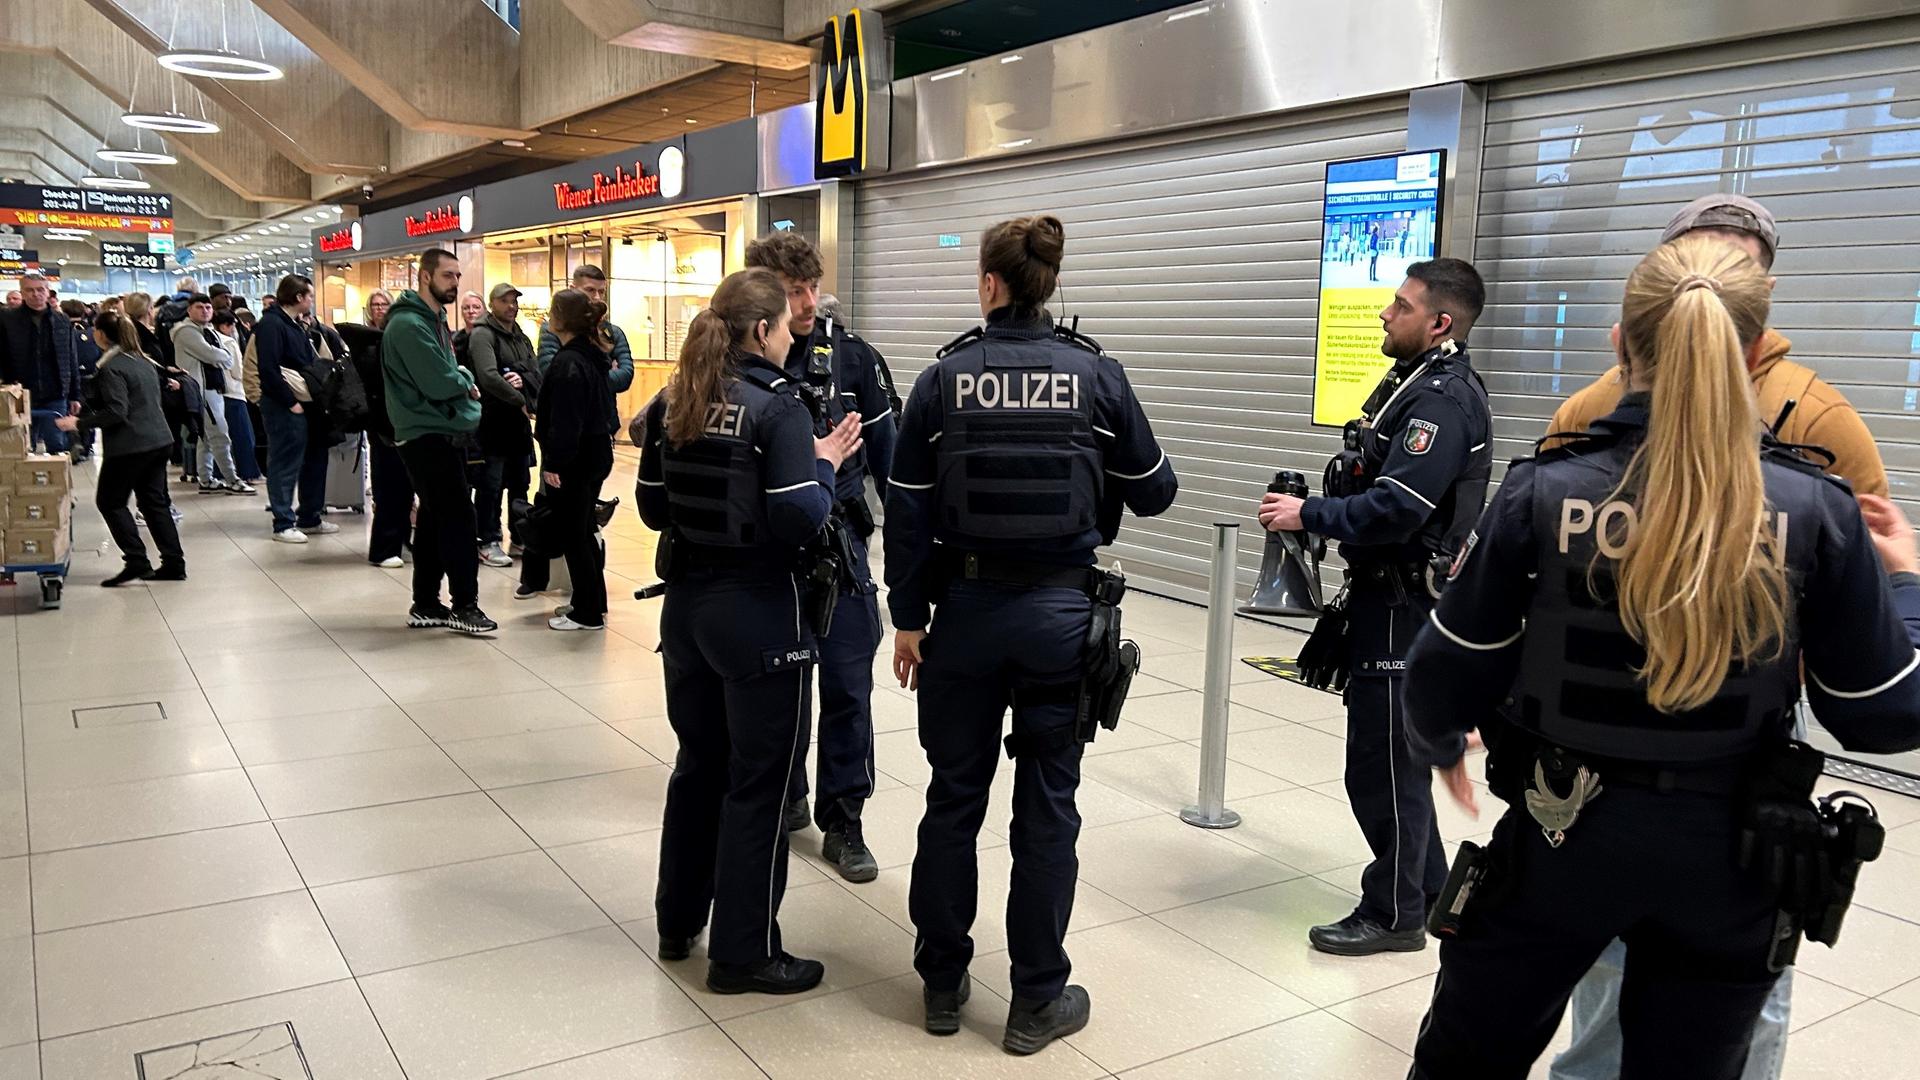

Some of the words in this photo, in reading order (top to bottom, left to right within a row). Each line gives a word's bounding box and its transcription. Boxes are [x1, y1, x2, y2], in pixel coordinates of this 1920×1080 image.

[554, 182, 592, 210] Wiener
[593, 161, 658, 204] Feinbäcker
[1418, 190, 1435, 199] CHECK
[103, 253, 158, 267] 201-220
[956, 372, 1079, 409] POLIZEI
[1376, 660, 1407, 670] POLIZE
